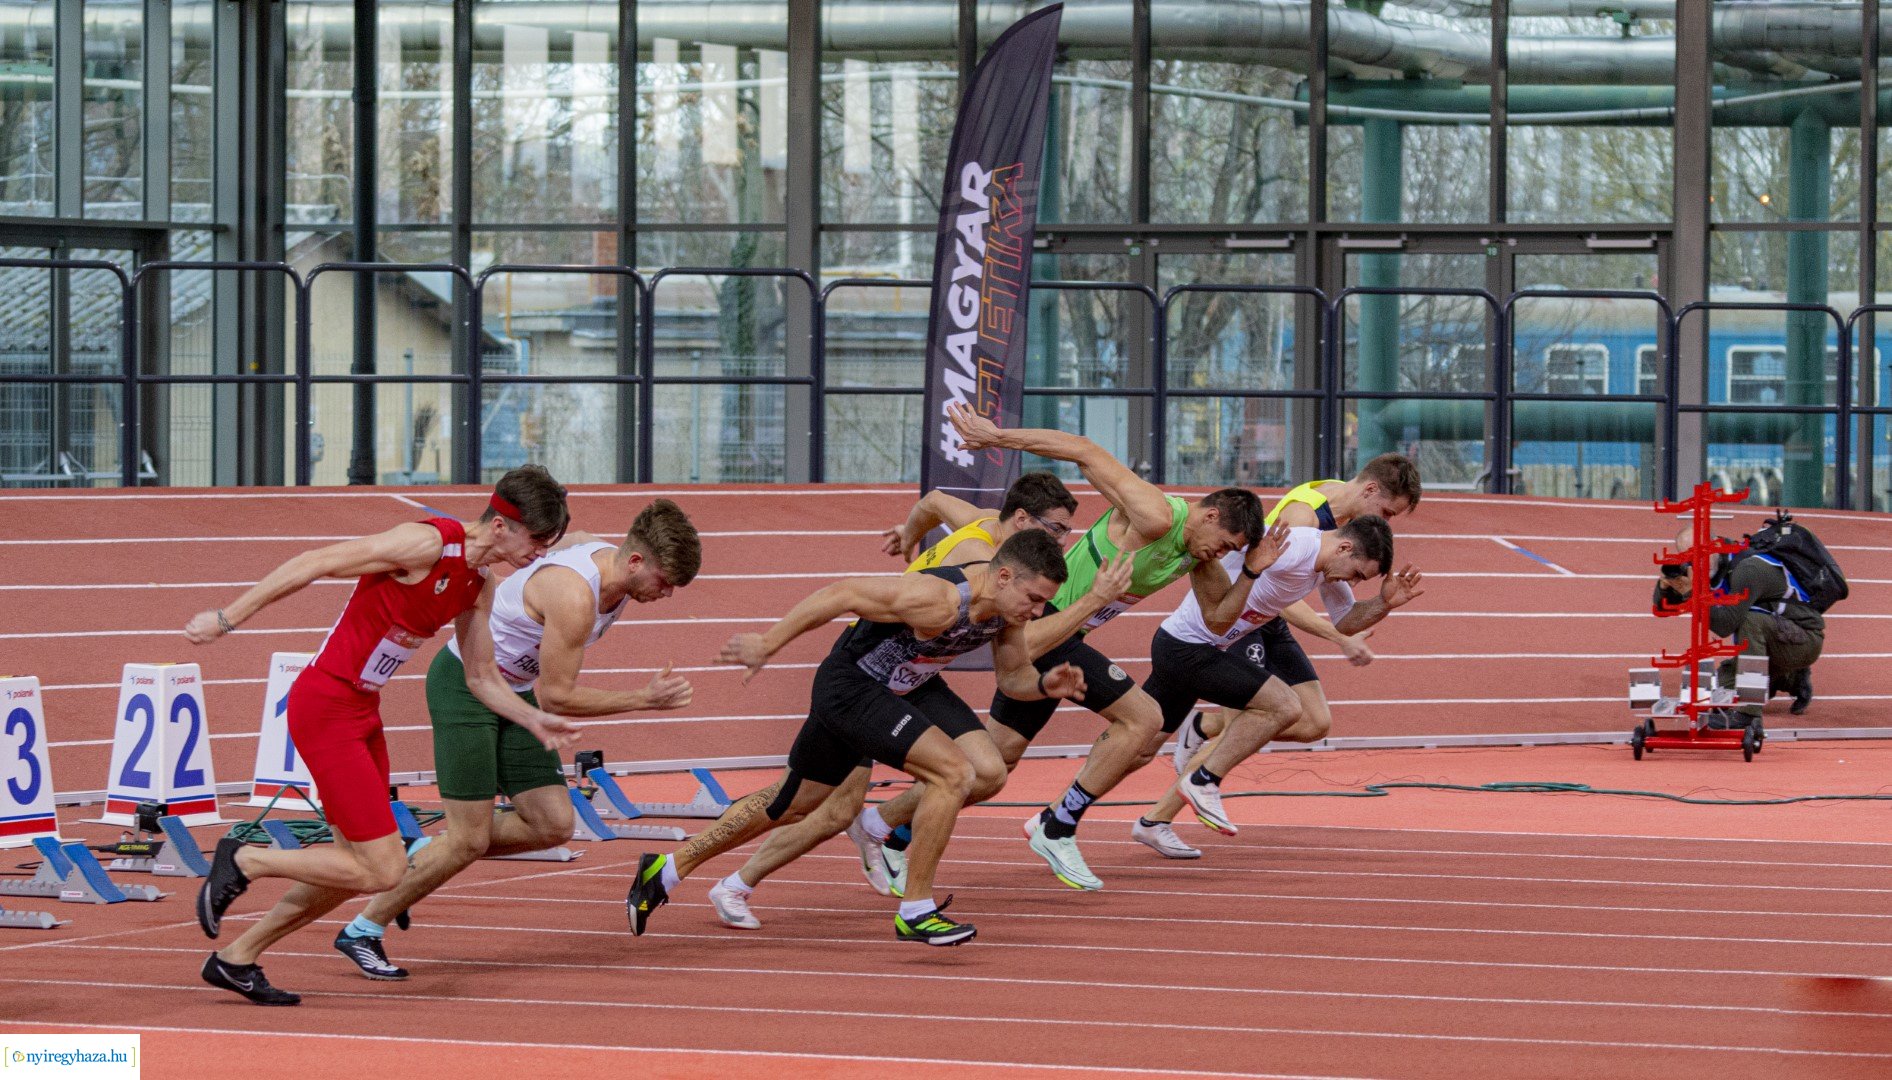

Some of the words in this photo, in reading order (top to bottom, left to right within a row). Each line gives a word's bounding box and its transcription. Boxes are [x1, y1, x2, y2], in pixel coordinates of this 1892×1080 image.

[940, 161, 993, 468] #MAGYAR
[5, 707, 42, 806] 3
[119, 693, 155, 789] 2
[169, 692, 205, 789] 2
